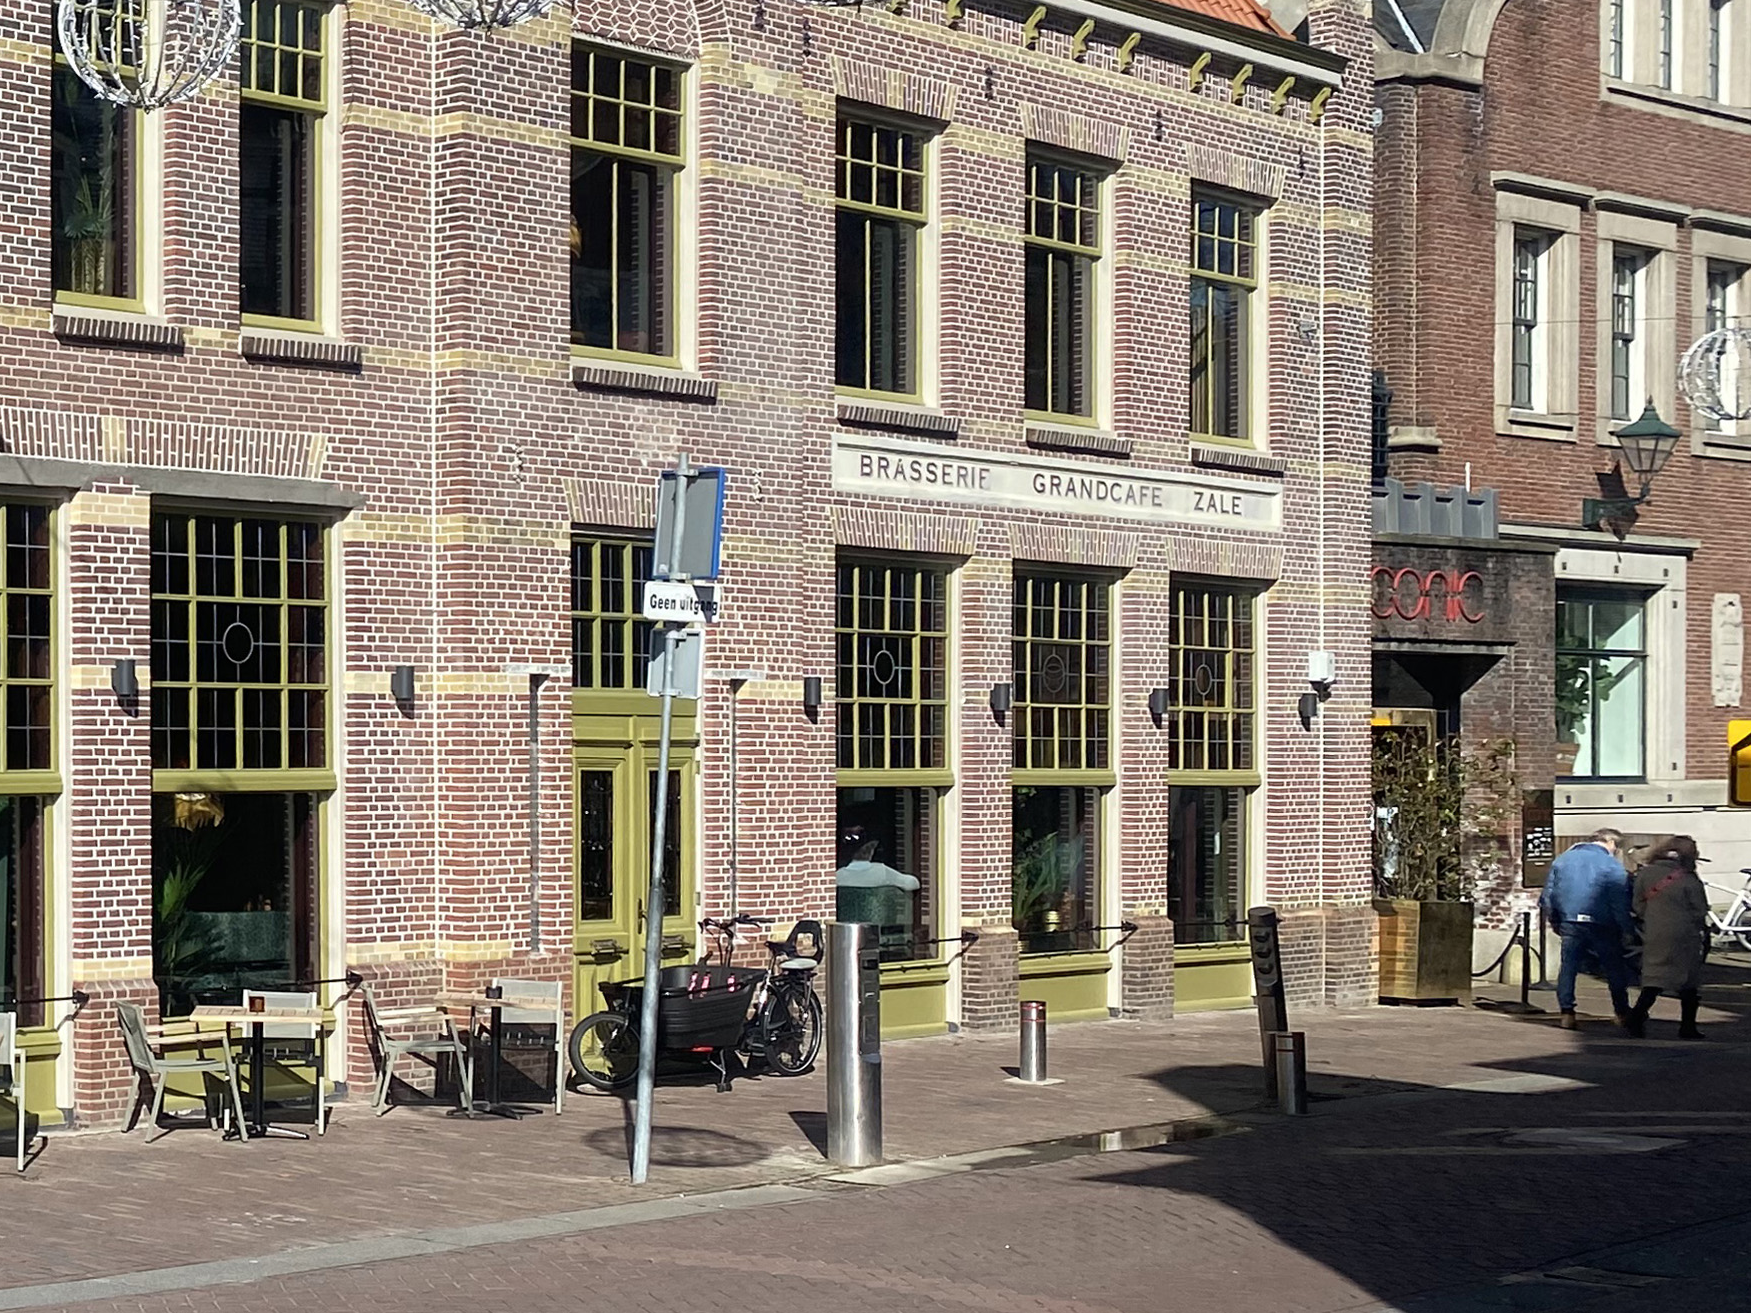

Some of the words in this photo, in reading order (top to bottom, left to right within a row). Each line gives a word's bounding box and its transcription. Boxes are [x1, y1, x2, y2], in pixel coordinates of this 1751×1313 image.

[859, 453, 991, 490] BRASSERIE
[1032, 472, 1164, 508] GRANDCAFE
[1193, 490, 1243, 515] ZALE
[650, 593, 676, 610] Geen
[680, 596, 718, 616] uitgang
